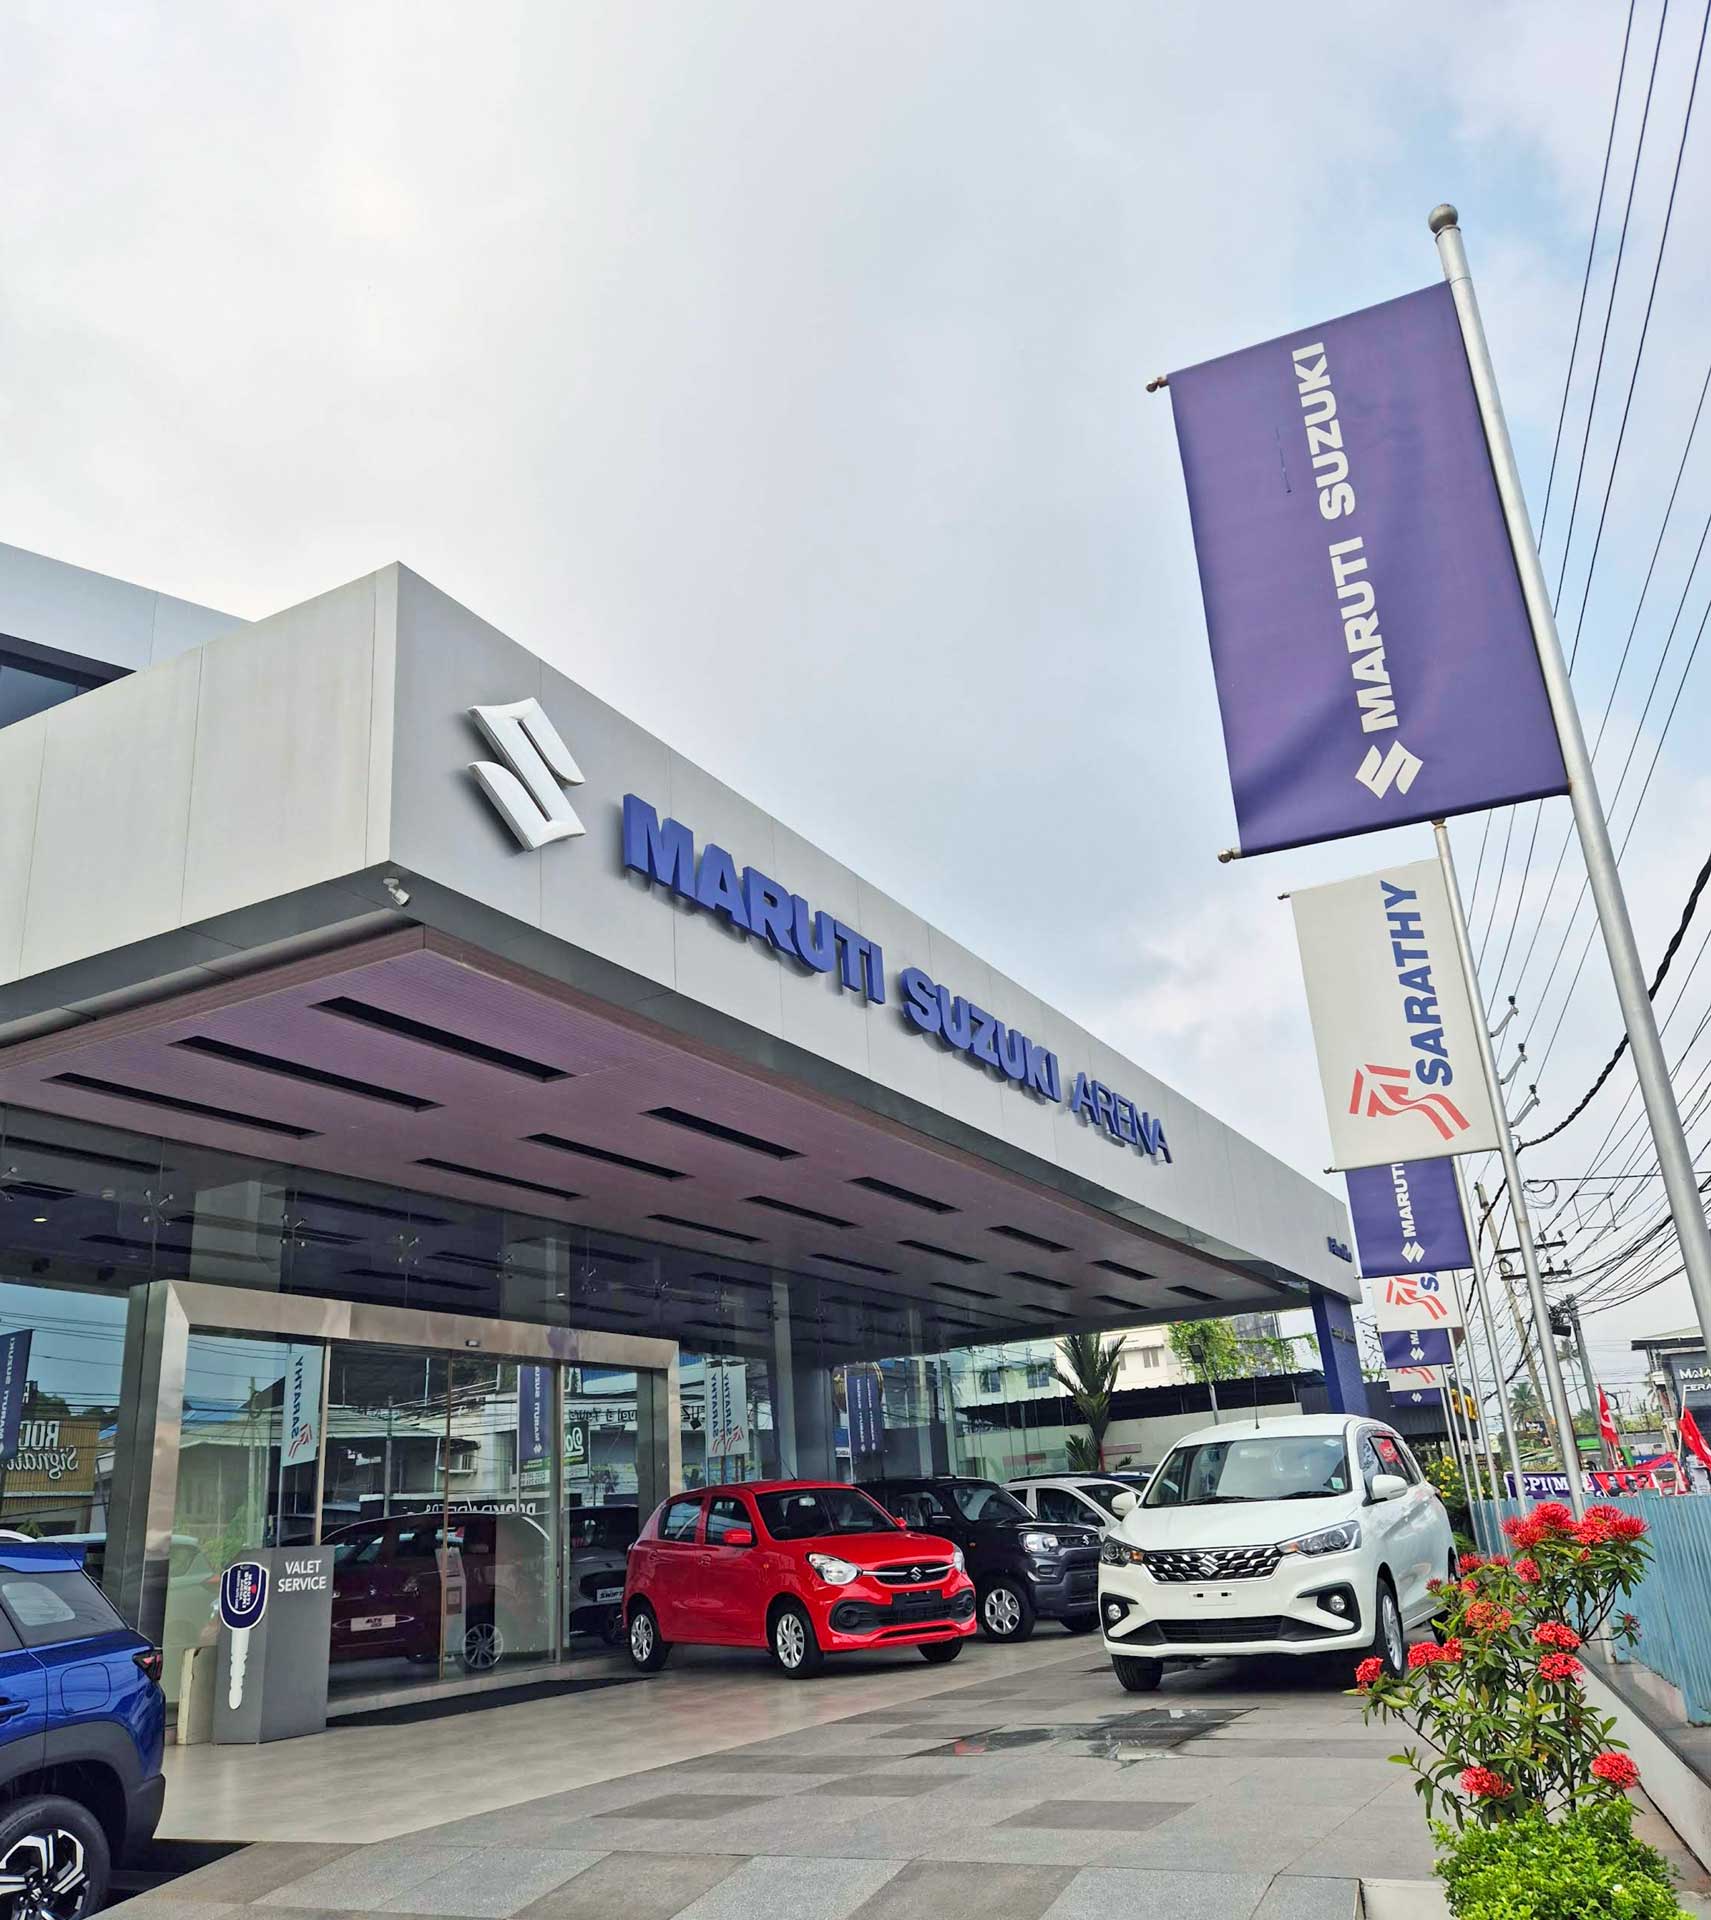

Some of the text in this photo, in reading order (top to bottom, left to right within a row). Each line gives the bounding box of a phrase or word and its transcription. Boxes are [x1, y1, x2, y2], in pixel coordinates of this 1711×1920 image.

[1292, 342, 1399, 733] MARUTI SUZUKI
[622, 793, 1173, 1164] MARUTI SUZUKI ARENA
[1380, 880, 1454, 1087] SARATHY
[1391, 1163, 1417, 1238] MARUTI
[1420, 1272, 1440, 1292] S
[278, 1576, 327, 1593] SERVICE
[285, 1560, 322, 1575] VALET
